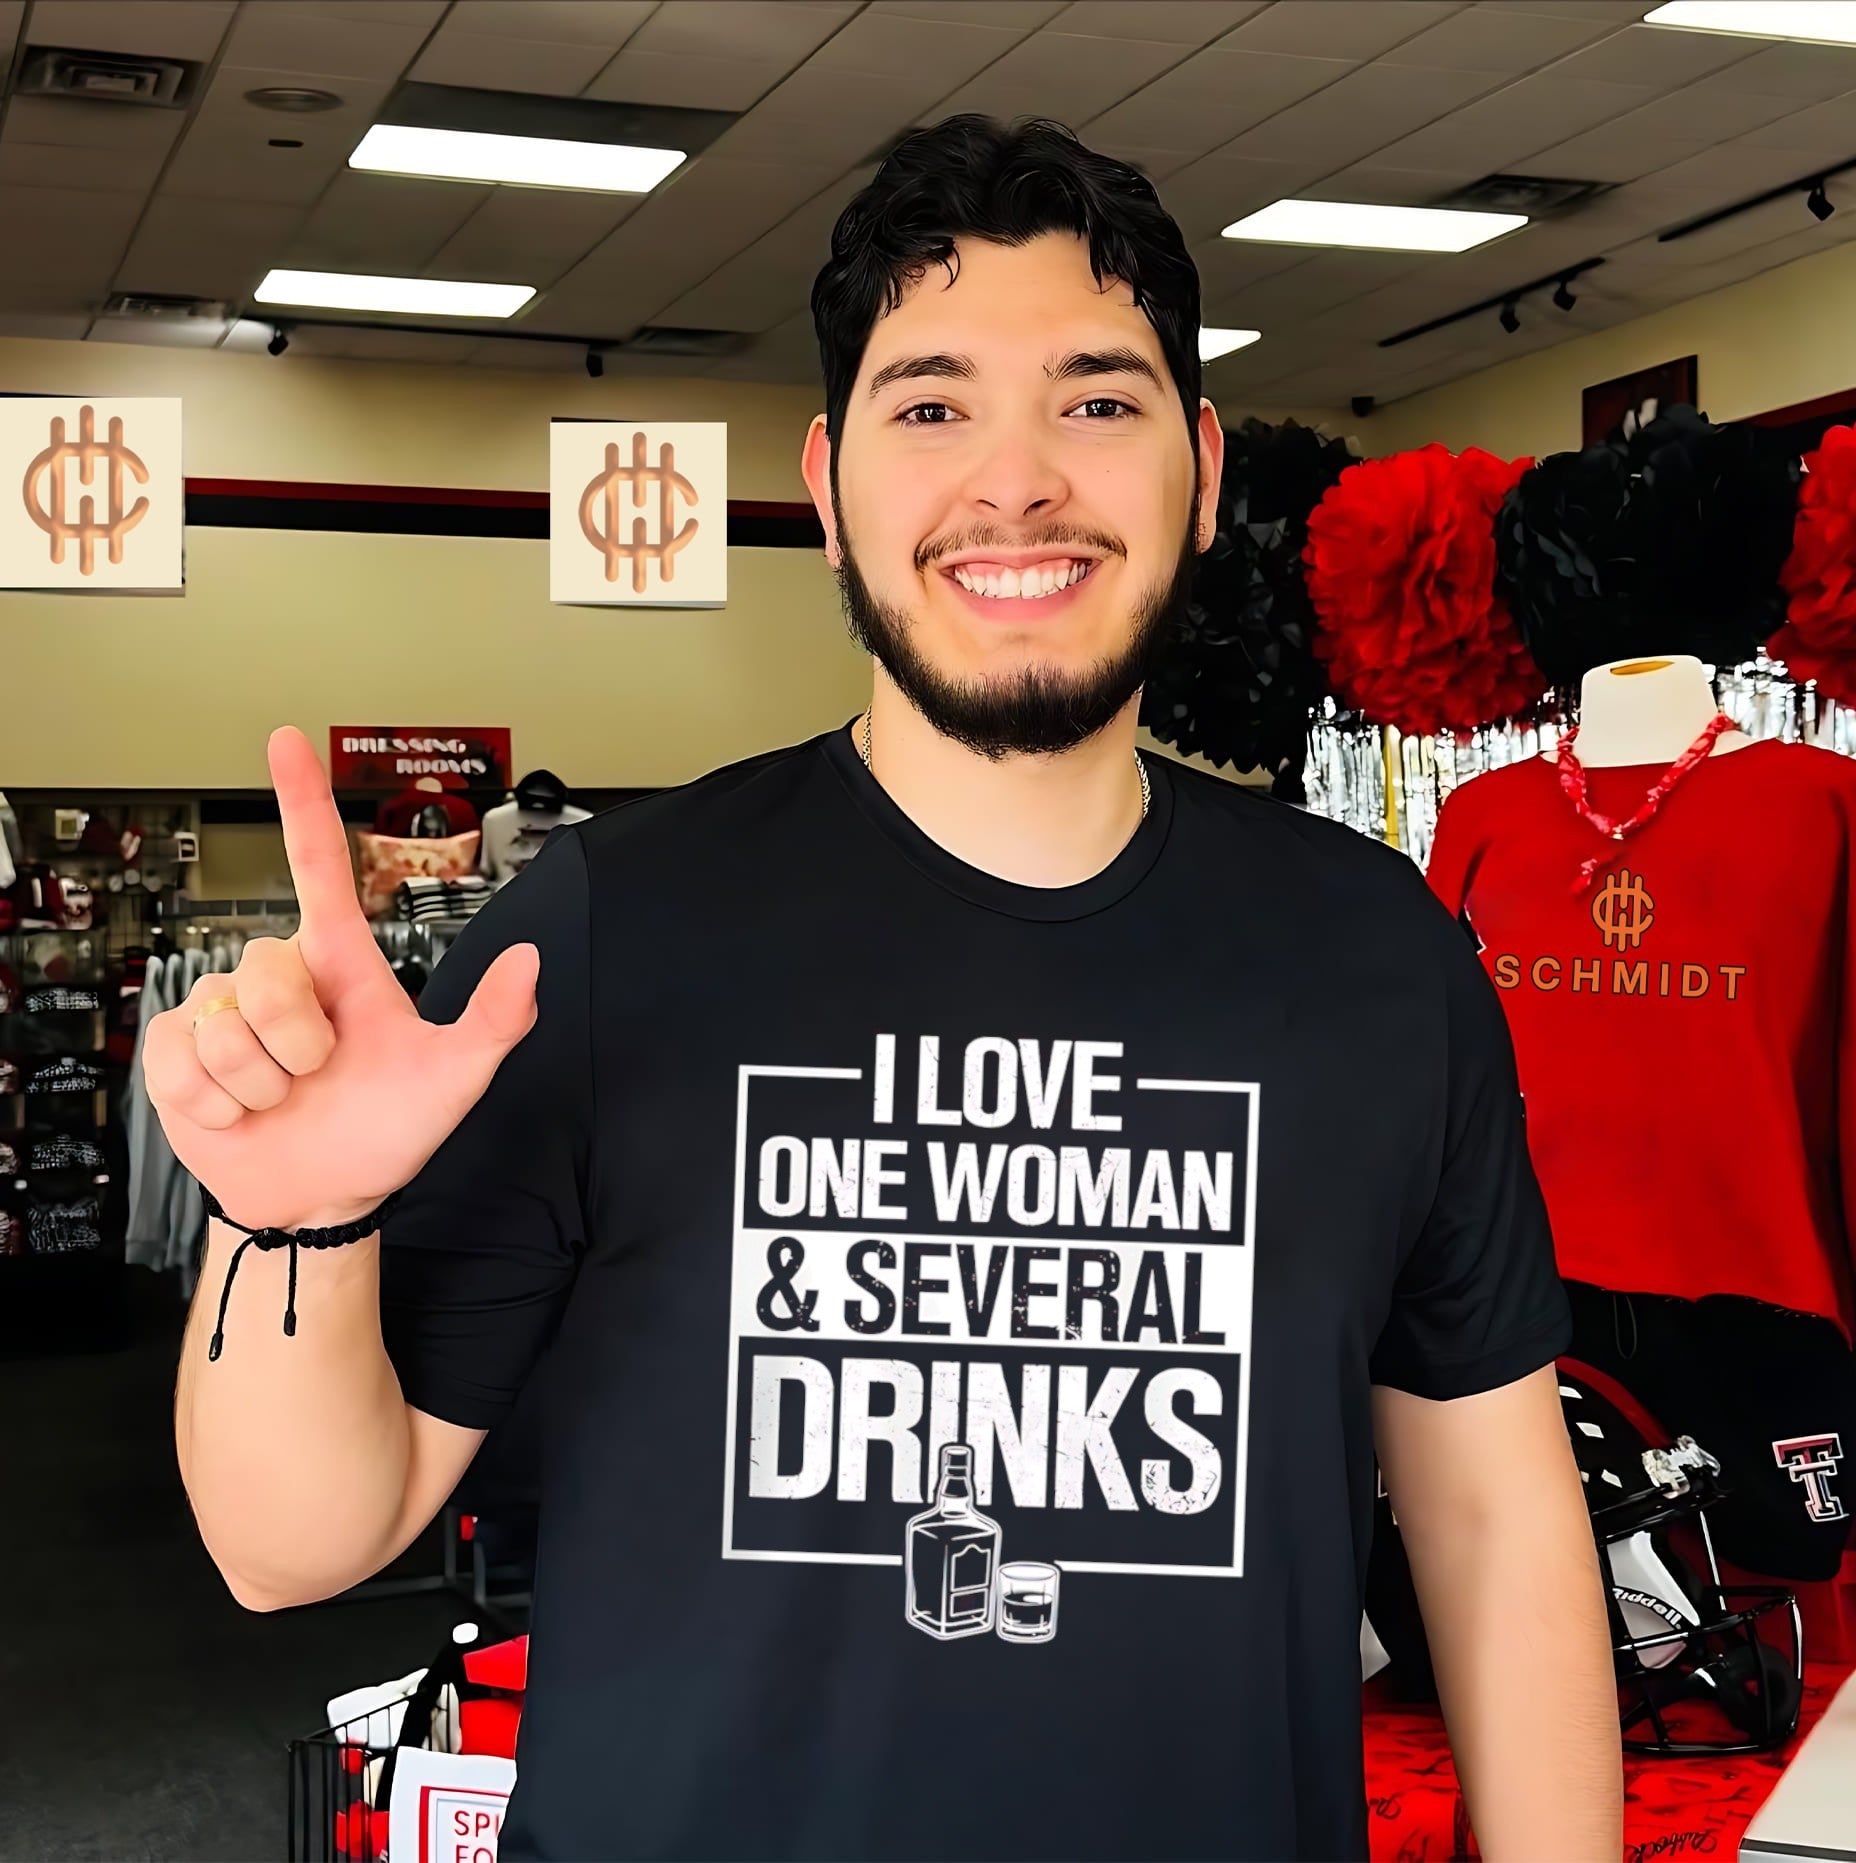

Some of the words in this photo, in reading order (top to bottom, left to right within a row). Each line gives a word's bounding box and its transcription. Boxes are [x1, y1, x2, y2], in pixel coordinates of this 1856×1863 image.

[342, 737, 467, 754] DRESSING
[396, 758, 487, 775] ROOMS
[1494, 953, 1746, 1000] SCHMIDT
[873, 1034, 896, 1124] I
[917, 1036, 1123, 1131] LOVE
[758, 1136, 908, 1220] ONE
[927, 1142, 1233, 1231] WOMAN
[756, 1236, 820, 1333] &
[844, 1239, 1226, 1345] SEVERAL
[748, 1354, 1223, 1515] DRINKS
